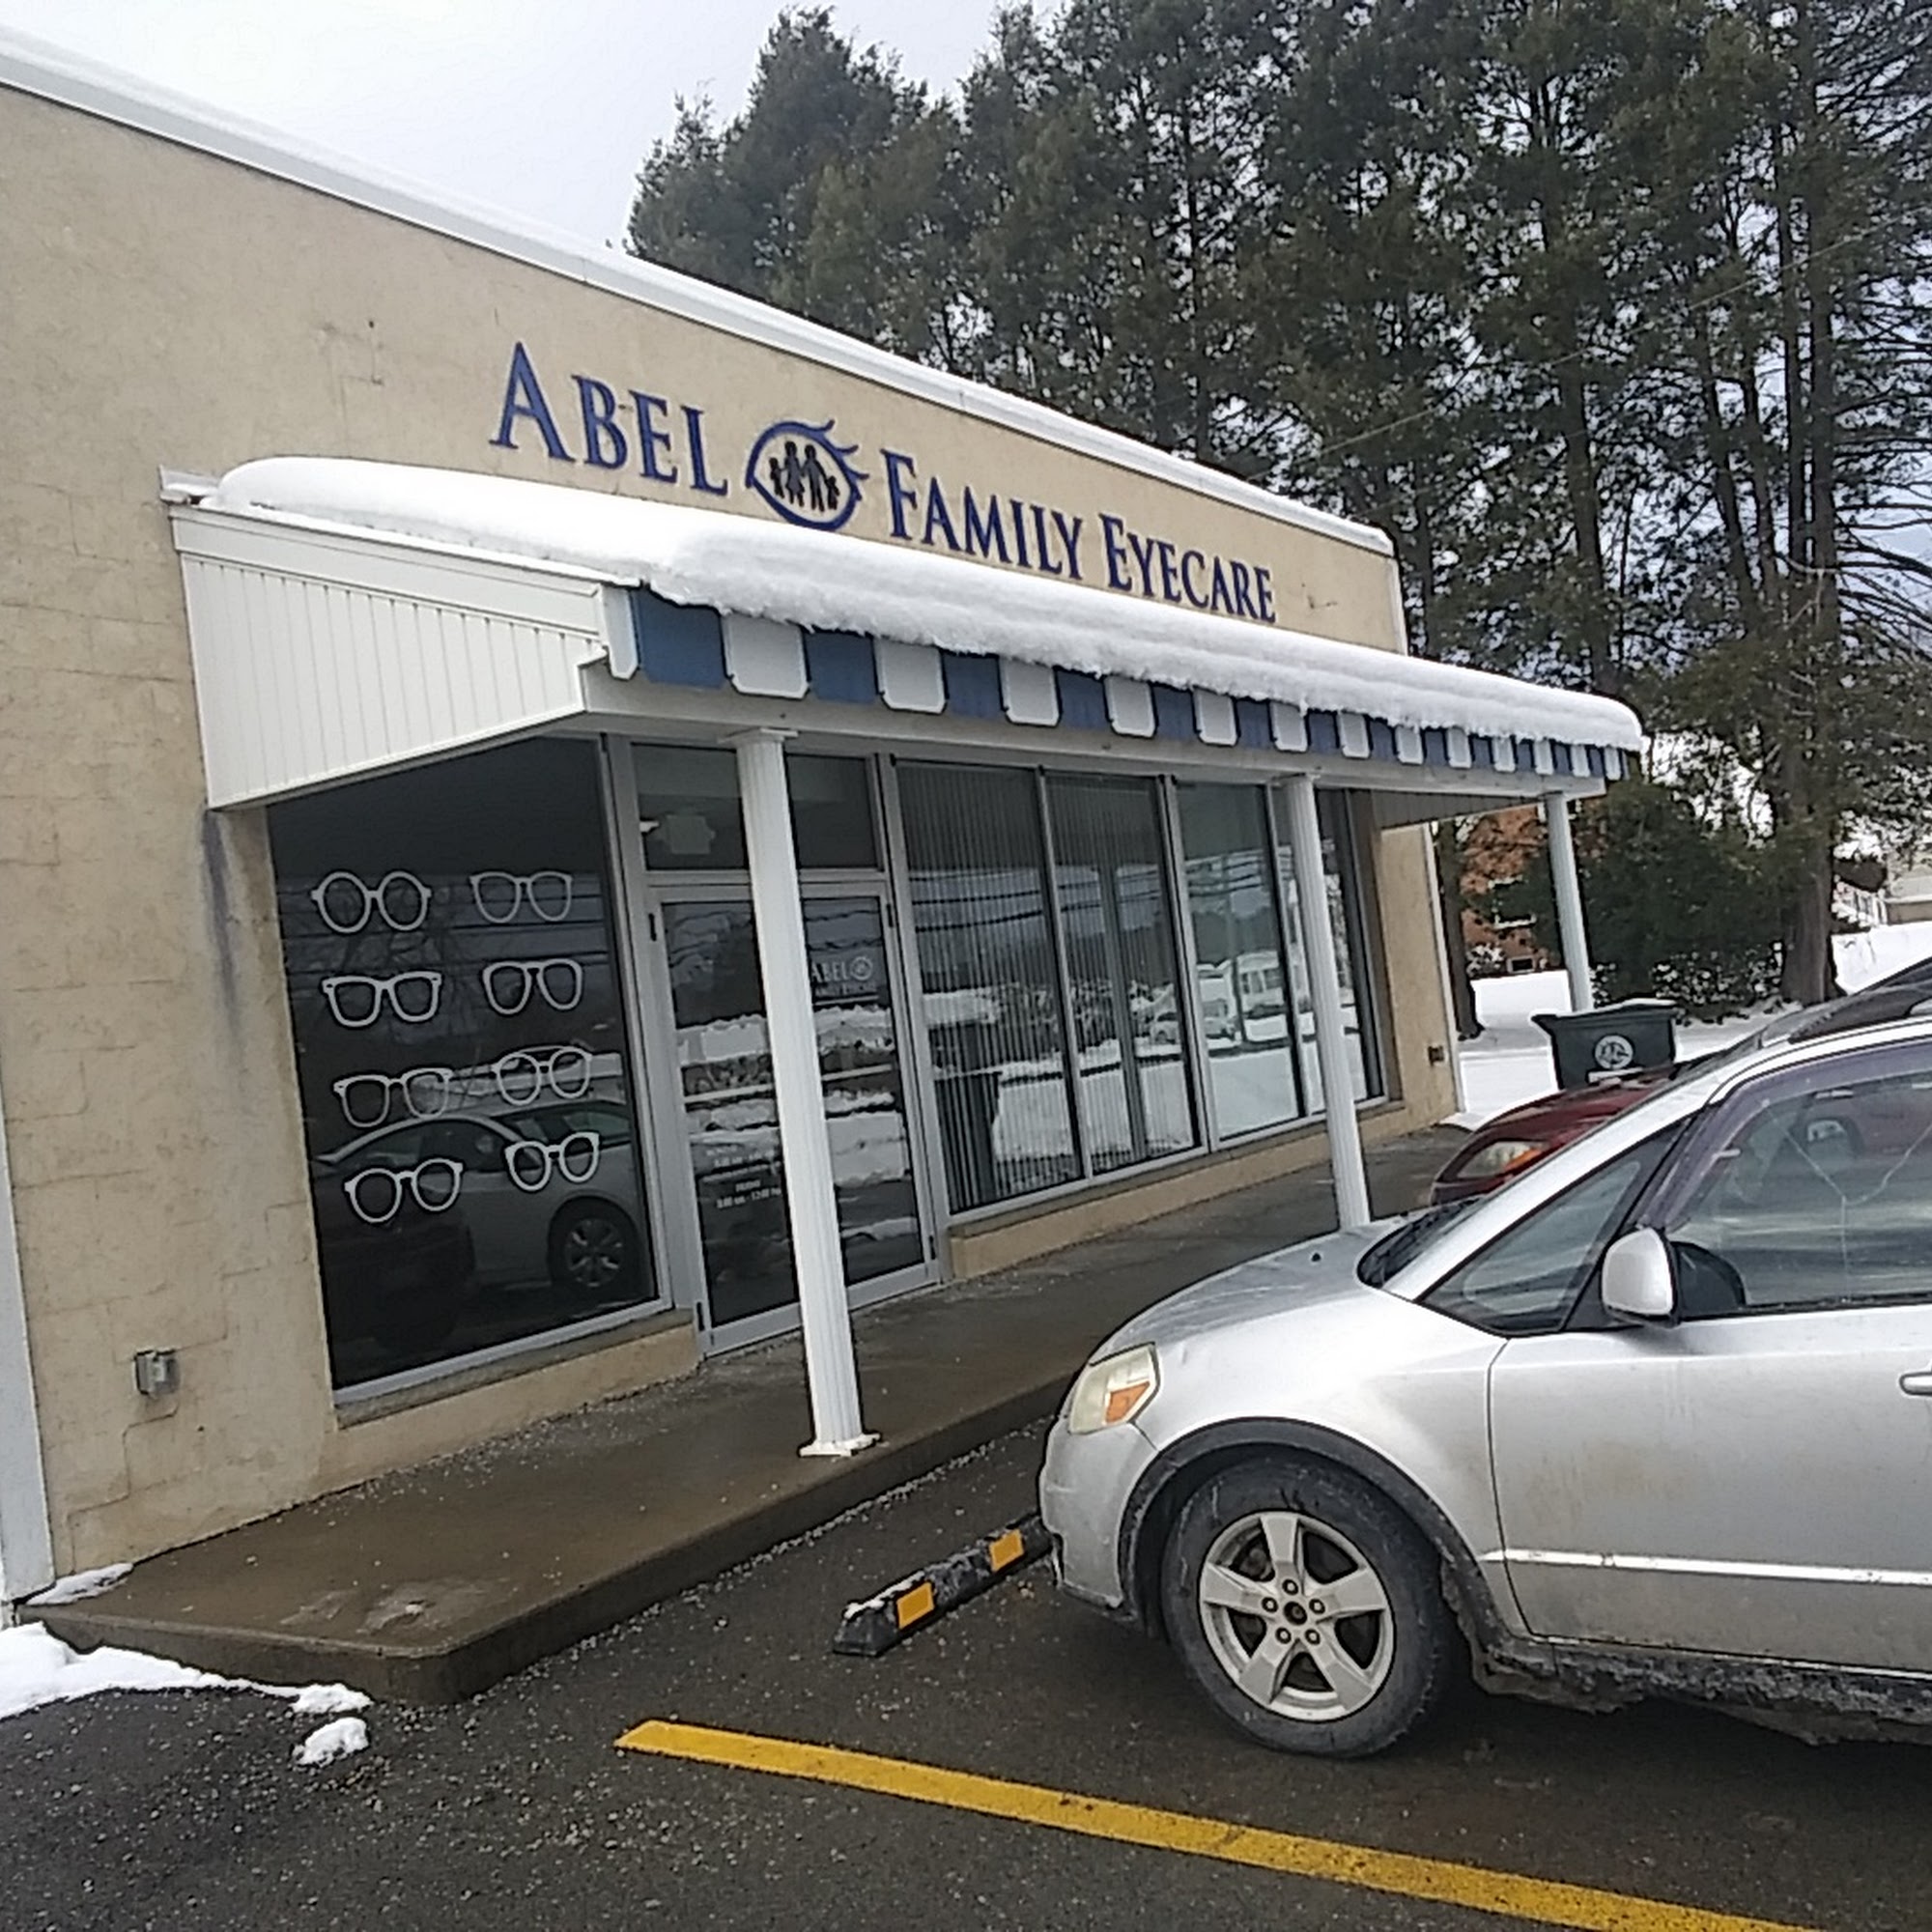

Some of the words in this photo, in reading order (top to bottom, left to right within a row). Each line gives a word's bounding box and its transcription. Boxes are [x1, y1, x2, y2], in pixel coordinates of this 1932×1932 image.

[489, 341, 728, 497] ABEL
[880, 448, 1083, 580] FAMILY
[1099, 513, 1276, 624] EYECARE
